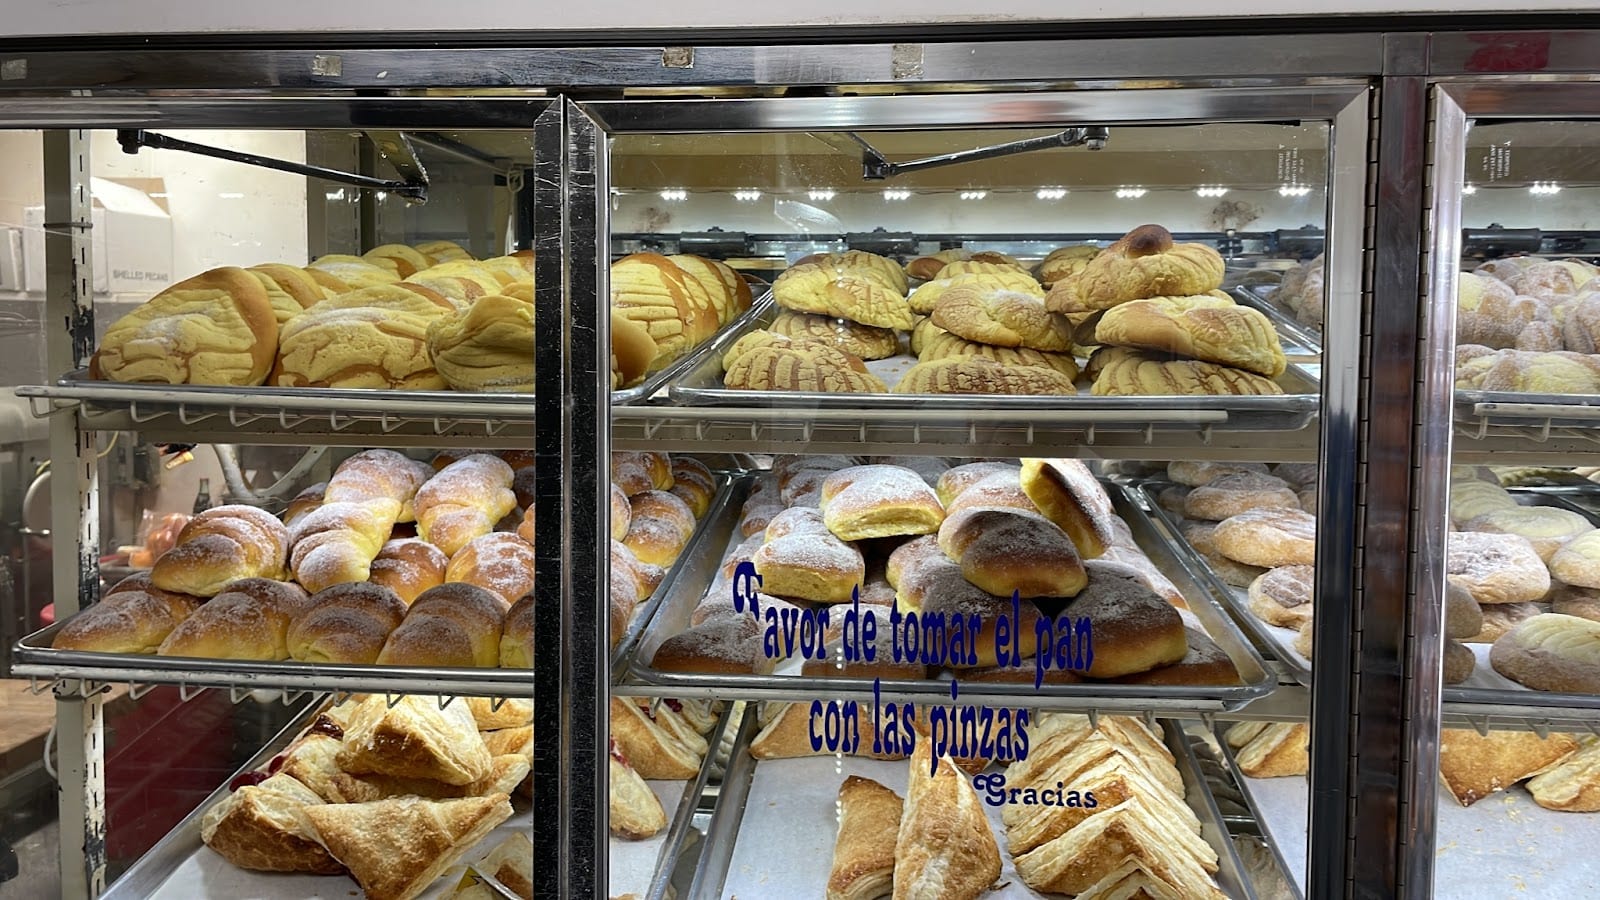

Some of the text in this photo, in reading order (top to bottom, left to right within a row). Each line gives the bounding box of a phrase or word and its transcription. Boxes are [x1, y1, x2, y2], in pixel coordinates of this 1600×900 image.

[843, 584, 878, 662] de
[890, 604, 982, 666] tomar
[995, 589, 1021, 668] el
[1035, 615, 1093, 690] pan
[809, 677, 1029, 778] con las pinzas
[973, 773, 1098, 808] Gracias
